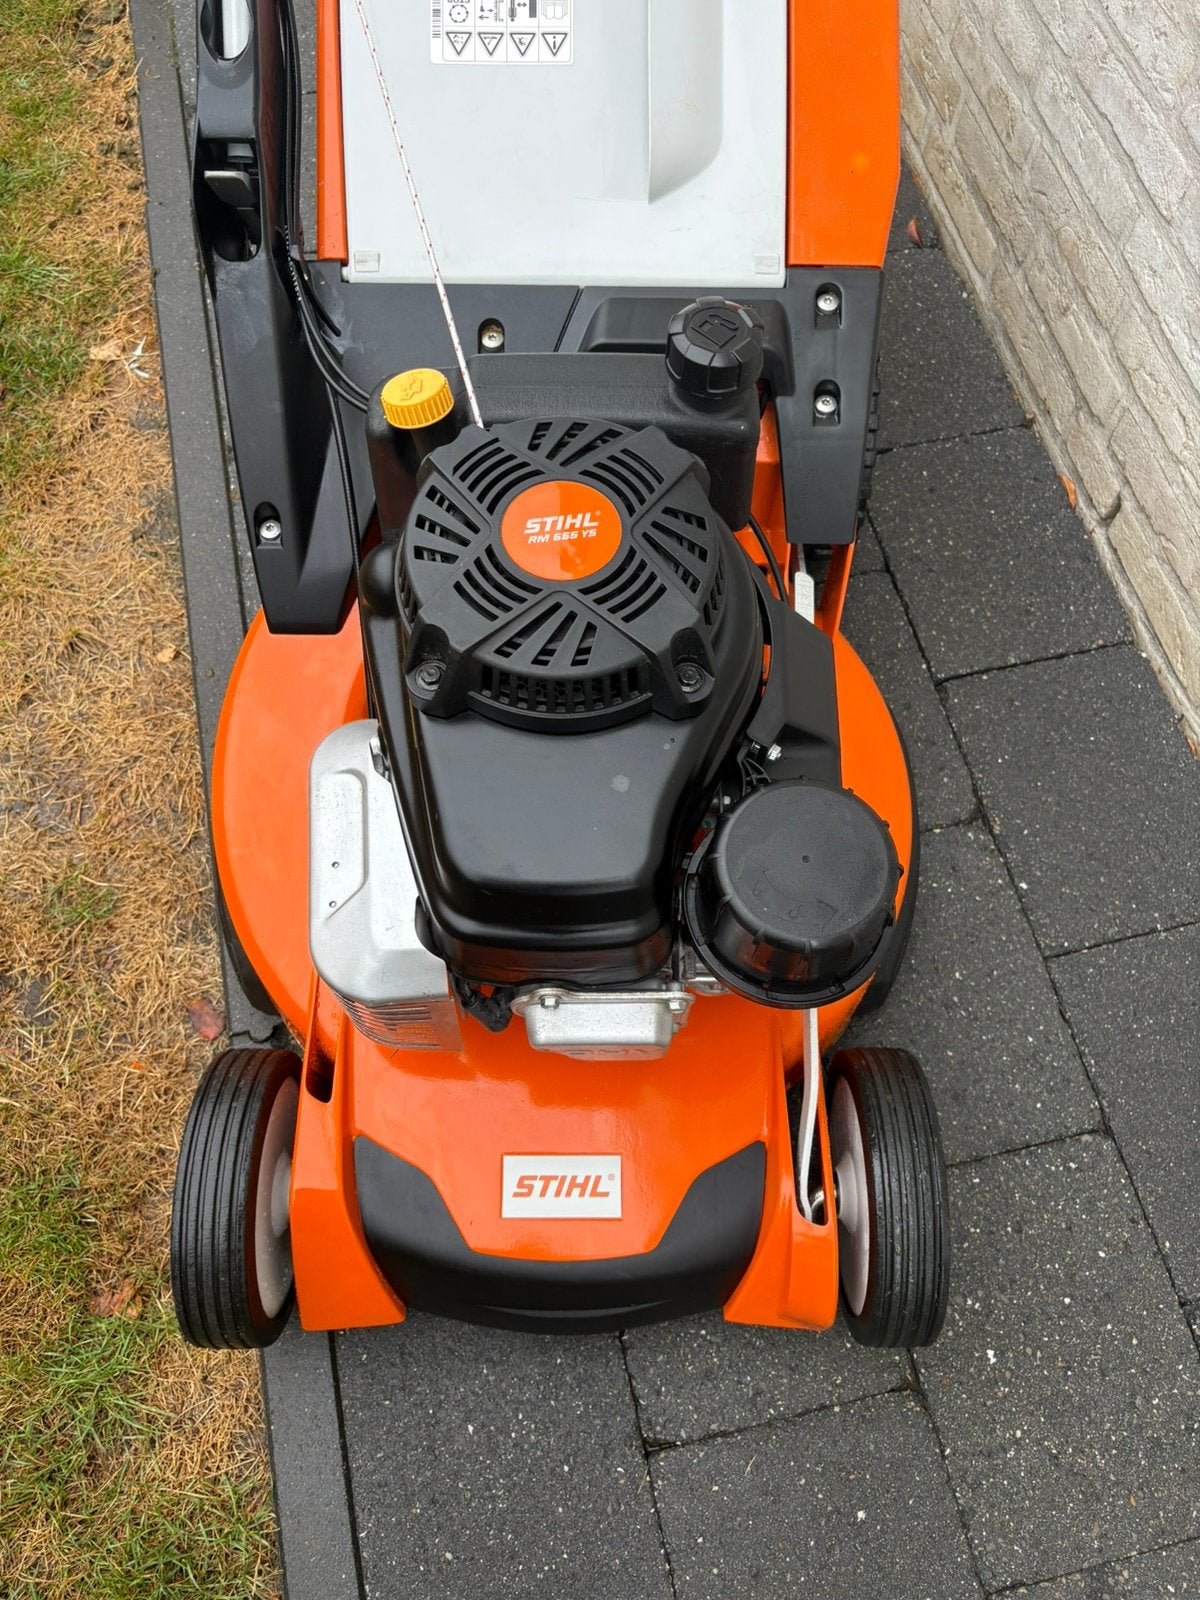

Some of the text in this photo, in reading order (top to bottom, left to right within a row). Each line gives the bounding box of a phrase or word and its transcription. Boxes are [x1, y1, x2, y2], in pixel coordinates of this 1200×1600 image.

[528, 529, 597, 544] RM 655 YS
